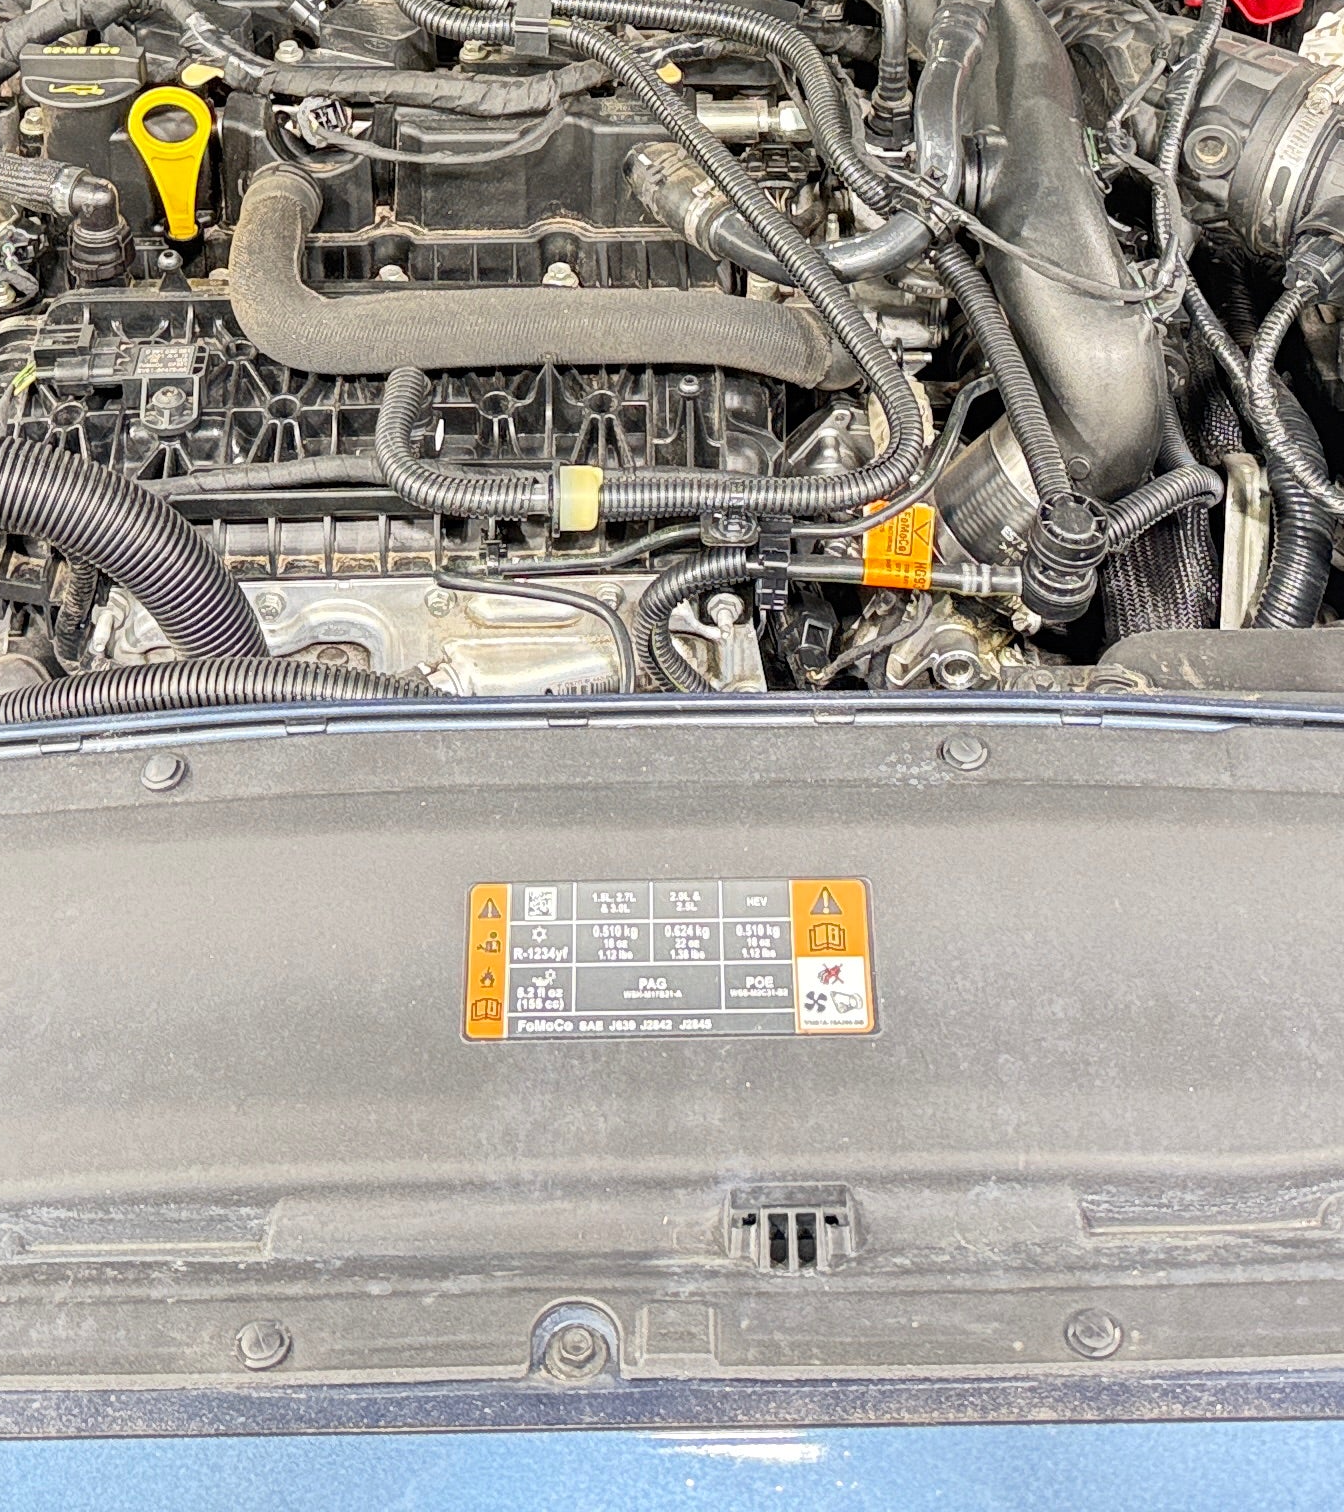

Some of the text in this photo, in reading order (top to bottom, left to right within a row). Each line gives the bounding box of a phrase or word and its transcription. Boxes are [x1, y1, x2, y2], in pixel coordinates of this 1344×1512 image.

[898, 511, 911, 552] FoMoCo
[692, 890, 702, 902] &
[746, 896, 768, 907] HEV
[592, 924, 639, 940] 0.510 kg
[664, 924, 711, 940] 0.624 kg
[735, 924, 781, 939] 0.510 kg
[616, 939, 628, 948] oz
[674, 938, 701, 948] 22 oz
[759, 938, 771, 948] oz
[513, 946, 569, 962] R-1234yf
[597, 949, 634, 961] 1.12 lbs
[690, 949, 706, 960] lbs
[741, 948, 777, 959] 1.12 lbs
[638, 977, 668, 990] PAG
[745, 976, 775, 989] POE
[536, 986, 546, 998] fl
[547, 988, 564, 998] oz
[517, 1019, 574, 1033] FoMoCo
[578, 1020, 604, 1032] SAE
[608, 1019, 637, 1032] J639
[639, 1019, 673, 1031] J2842
